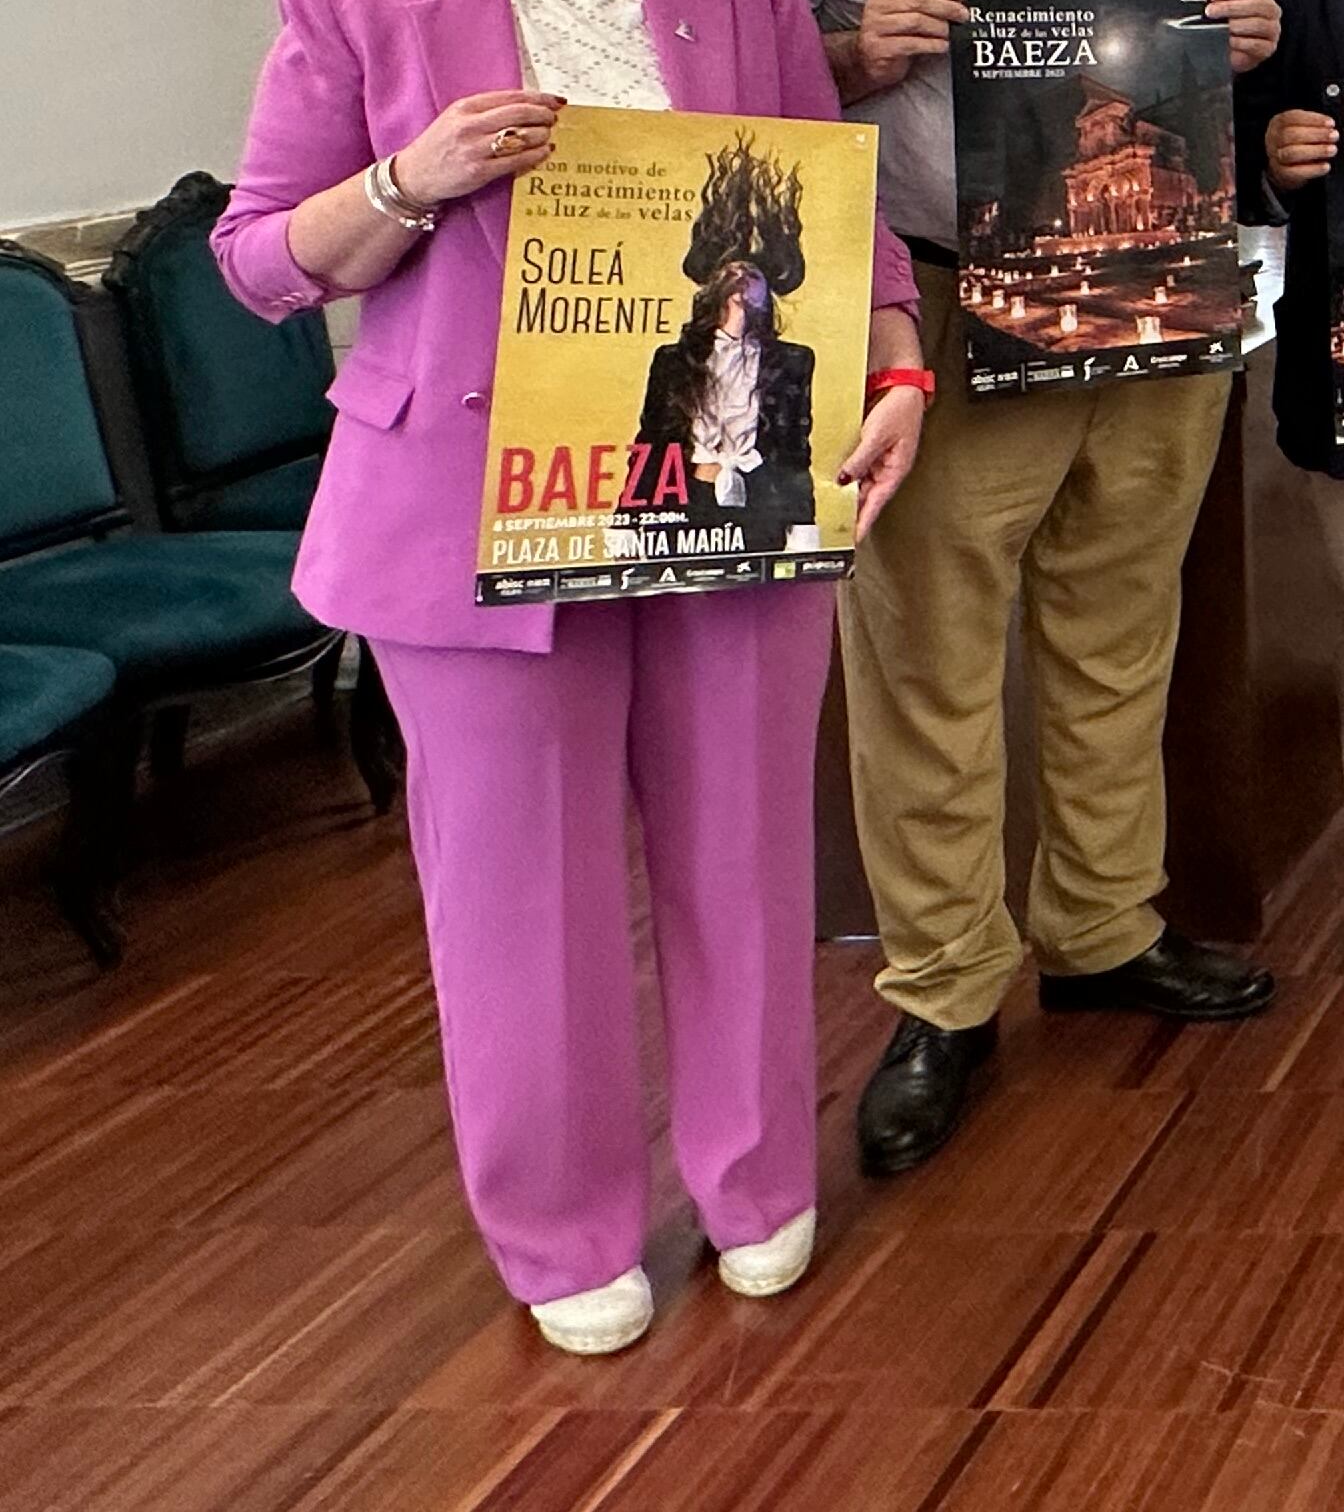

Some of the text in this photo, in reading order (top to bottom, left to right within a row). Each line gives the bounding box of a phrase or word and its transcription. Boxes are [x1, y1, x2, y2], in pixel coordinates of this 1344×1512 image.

[969, 6, 1095, 24] Renacimiento
[990, 23, 1094, 39] luz velas
[973, 39, 1098, 67] BAEZA
[532, 160, 668, 177] on motivo de
[528, 176, 696, 202] Renacimiento
[554, 199, 591, 218] luz
[639, 203, 694, 221] velas
[520, 237, 624, 286] SOLEÁ
[516, 286, 673, 334] MORENTE
[497, 442, 689, 514] BAEZA
[505, 517, 595, 532] SEPTIEMBRE
[492, 522, 746, 565] PLAZA DE SANTA MARÍA
